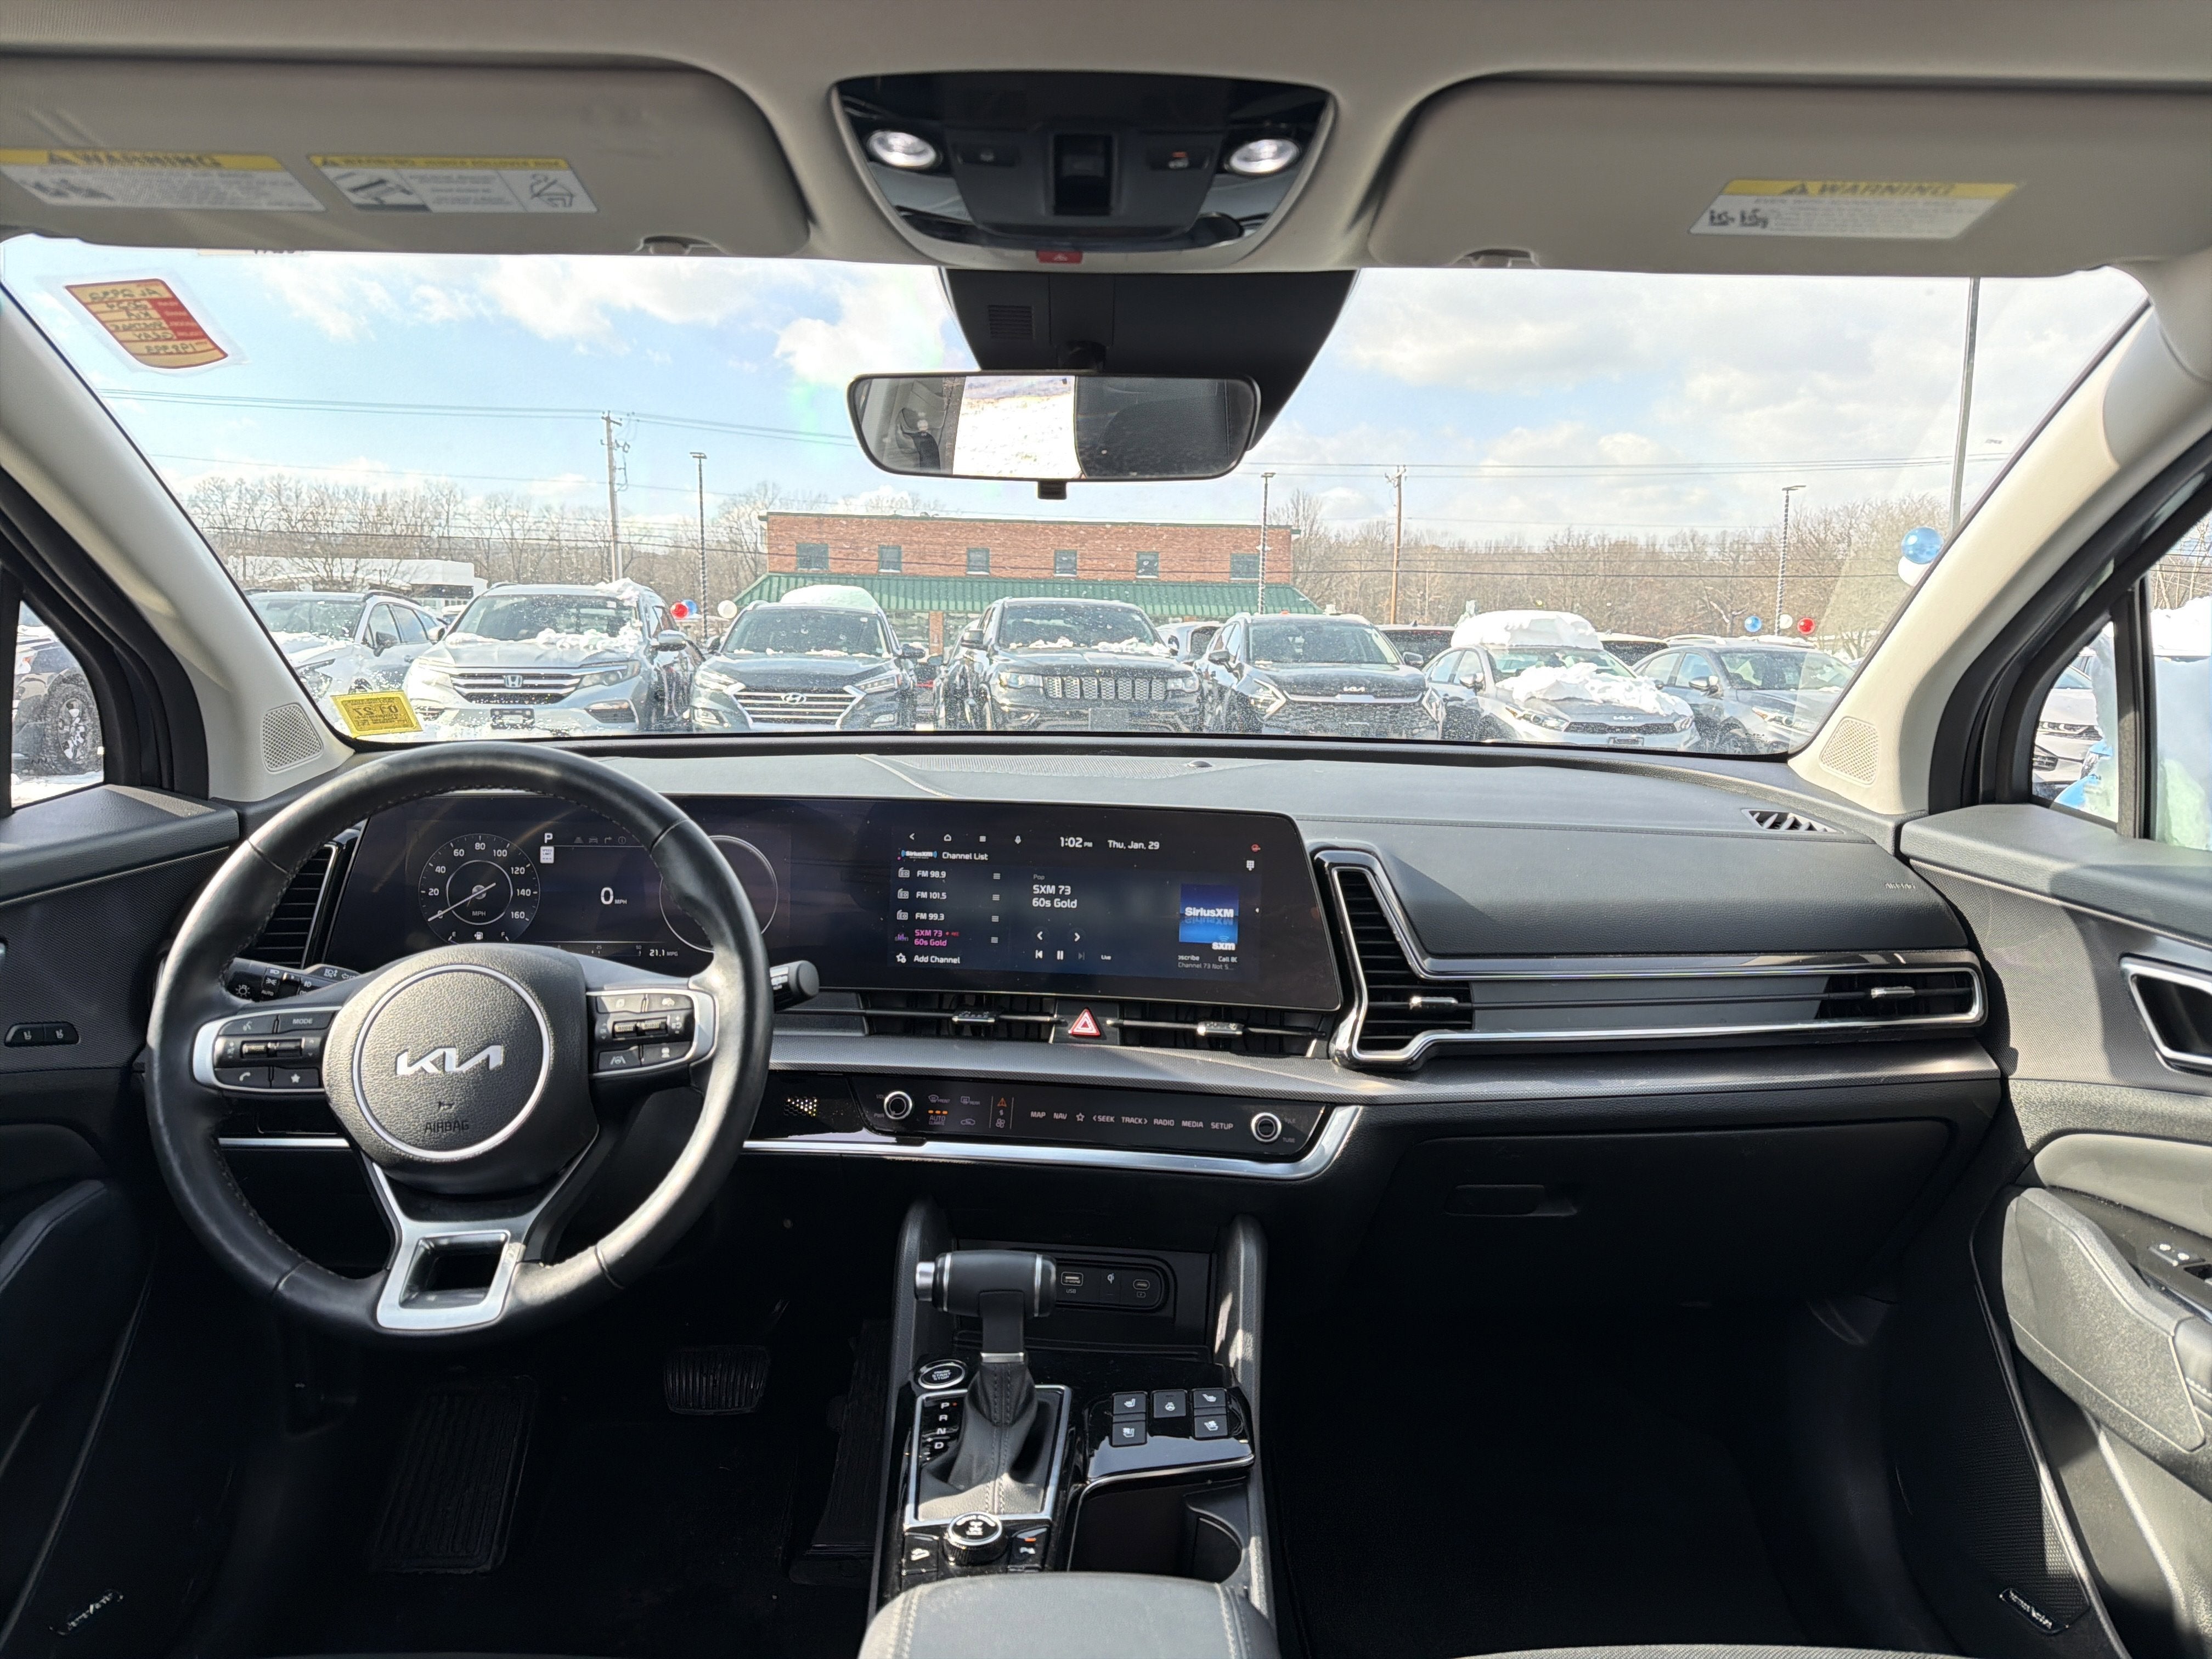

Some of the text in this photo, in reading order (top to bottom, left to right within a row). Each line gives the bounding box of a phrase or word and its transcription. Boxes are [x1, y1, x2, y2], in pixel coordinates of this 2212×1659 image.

[544, 833, 553, 843] P
[1060, 837, 1083, 848] 1:02
[1148, 841, 1160, 850] 29
[453, 849, 465, 857] 60
[942, 851, 972, 860] Channel
[435, 865, 446, 873] 40
[428, 887, 439, 895] 20
[516, 888, 531, 896] 140
[1032, 884, 1071, 895] SXM 73
[600, 887, 613, 905] 0
[916, 891, 947, 900] FM 101.5
[1032, 898, 1077, 909] 60s Gold
[510, 911, 525, 919] 160
[1184, 907, 1234, 918] SiriusXM
[1211, 942, 1235, 950] sxm
[913, 955, 960, 964] Add Channel
[396, 1045, 504, 1075] KIA
[424, 1120, 469, 1133] AIRBAG
[1154, 1118, 1175, 1126] RADIO
